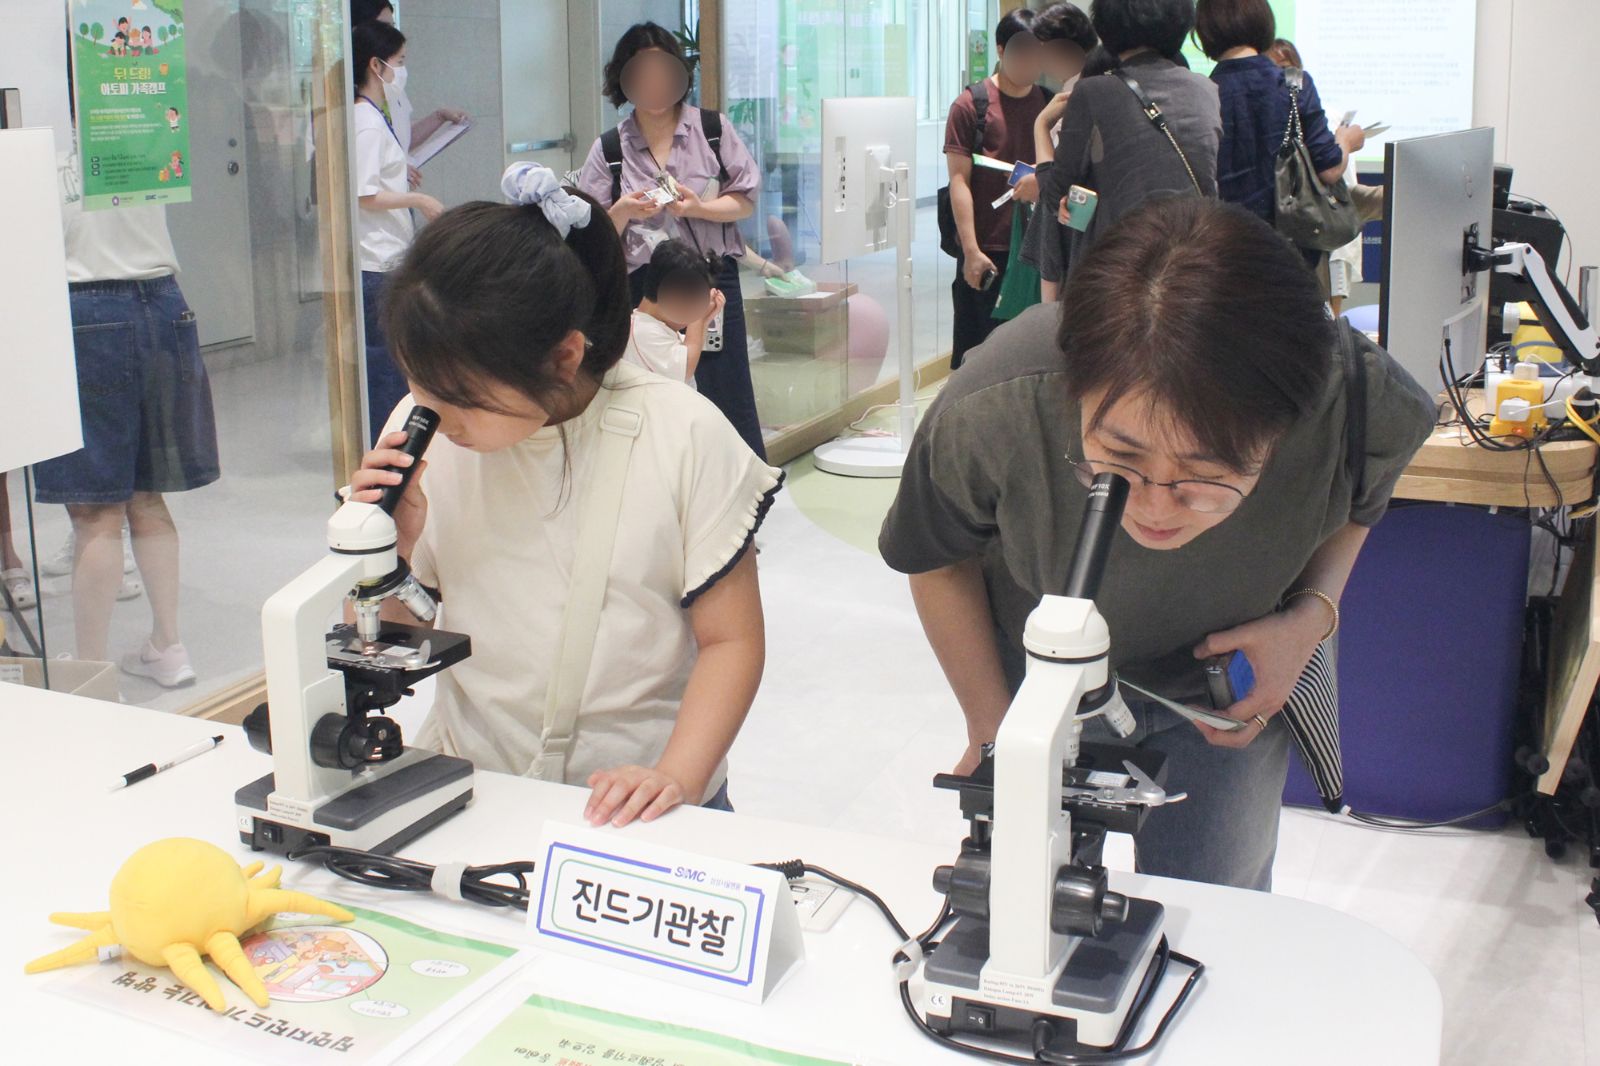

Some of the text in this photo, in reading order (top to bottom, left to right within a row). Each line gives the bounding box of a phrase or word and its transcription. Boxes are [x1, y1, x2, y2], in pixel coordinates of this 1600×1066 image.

[100, 82, 167, 96] 아토피 가족캠프
[674, 866, 706, 884] SMC
[571, 878, 735, 957] 진드기관찰
[111, 971, 157, 993] 방법
[221, 1006, 355, 1053] 집먼지진드기
